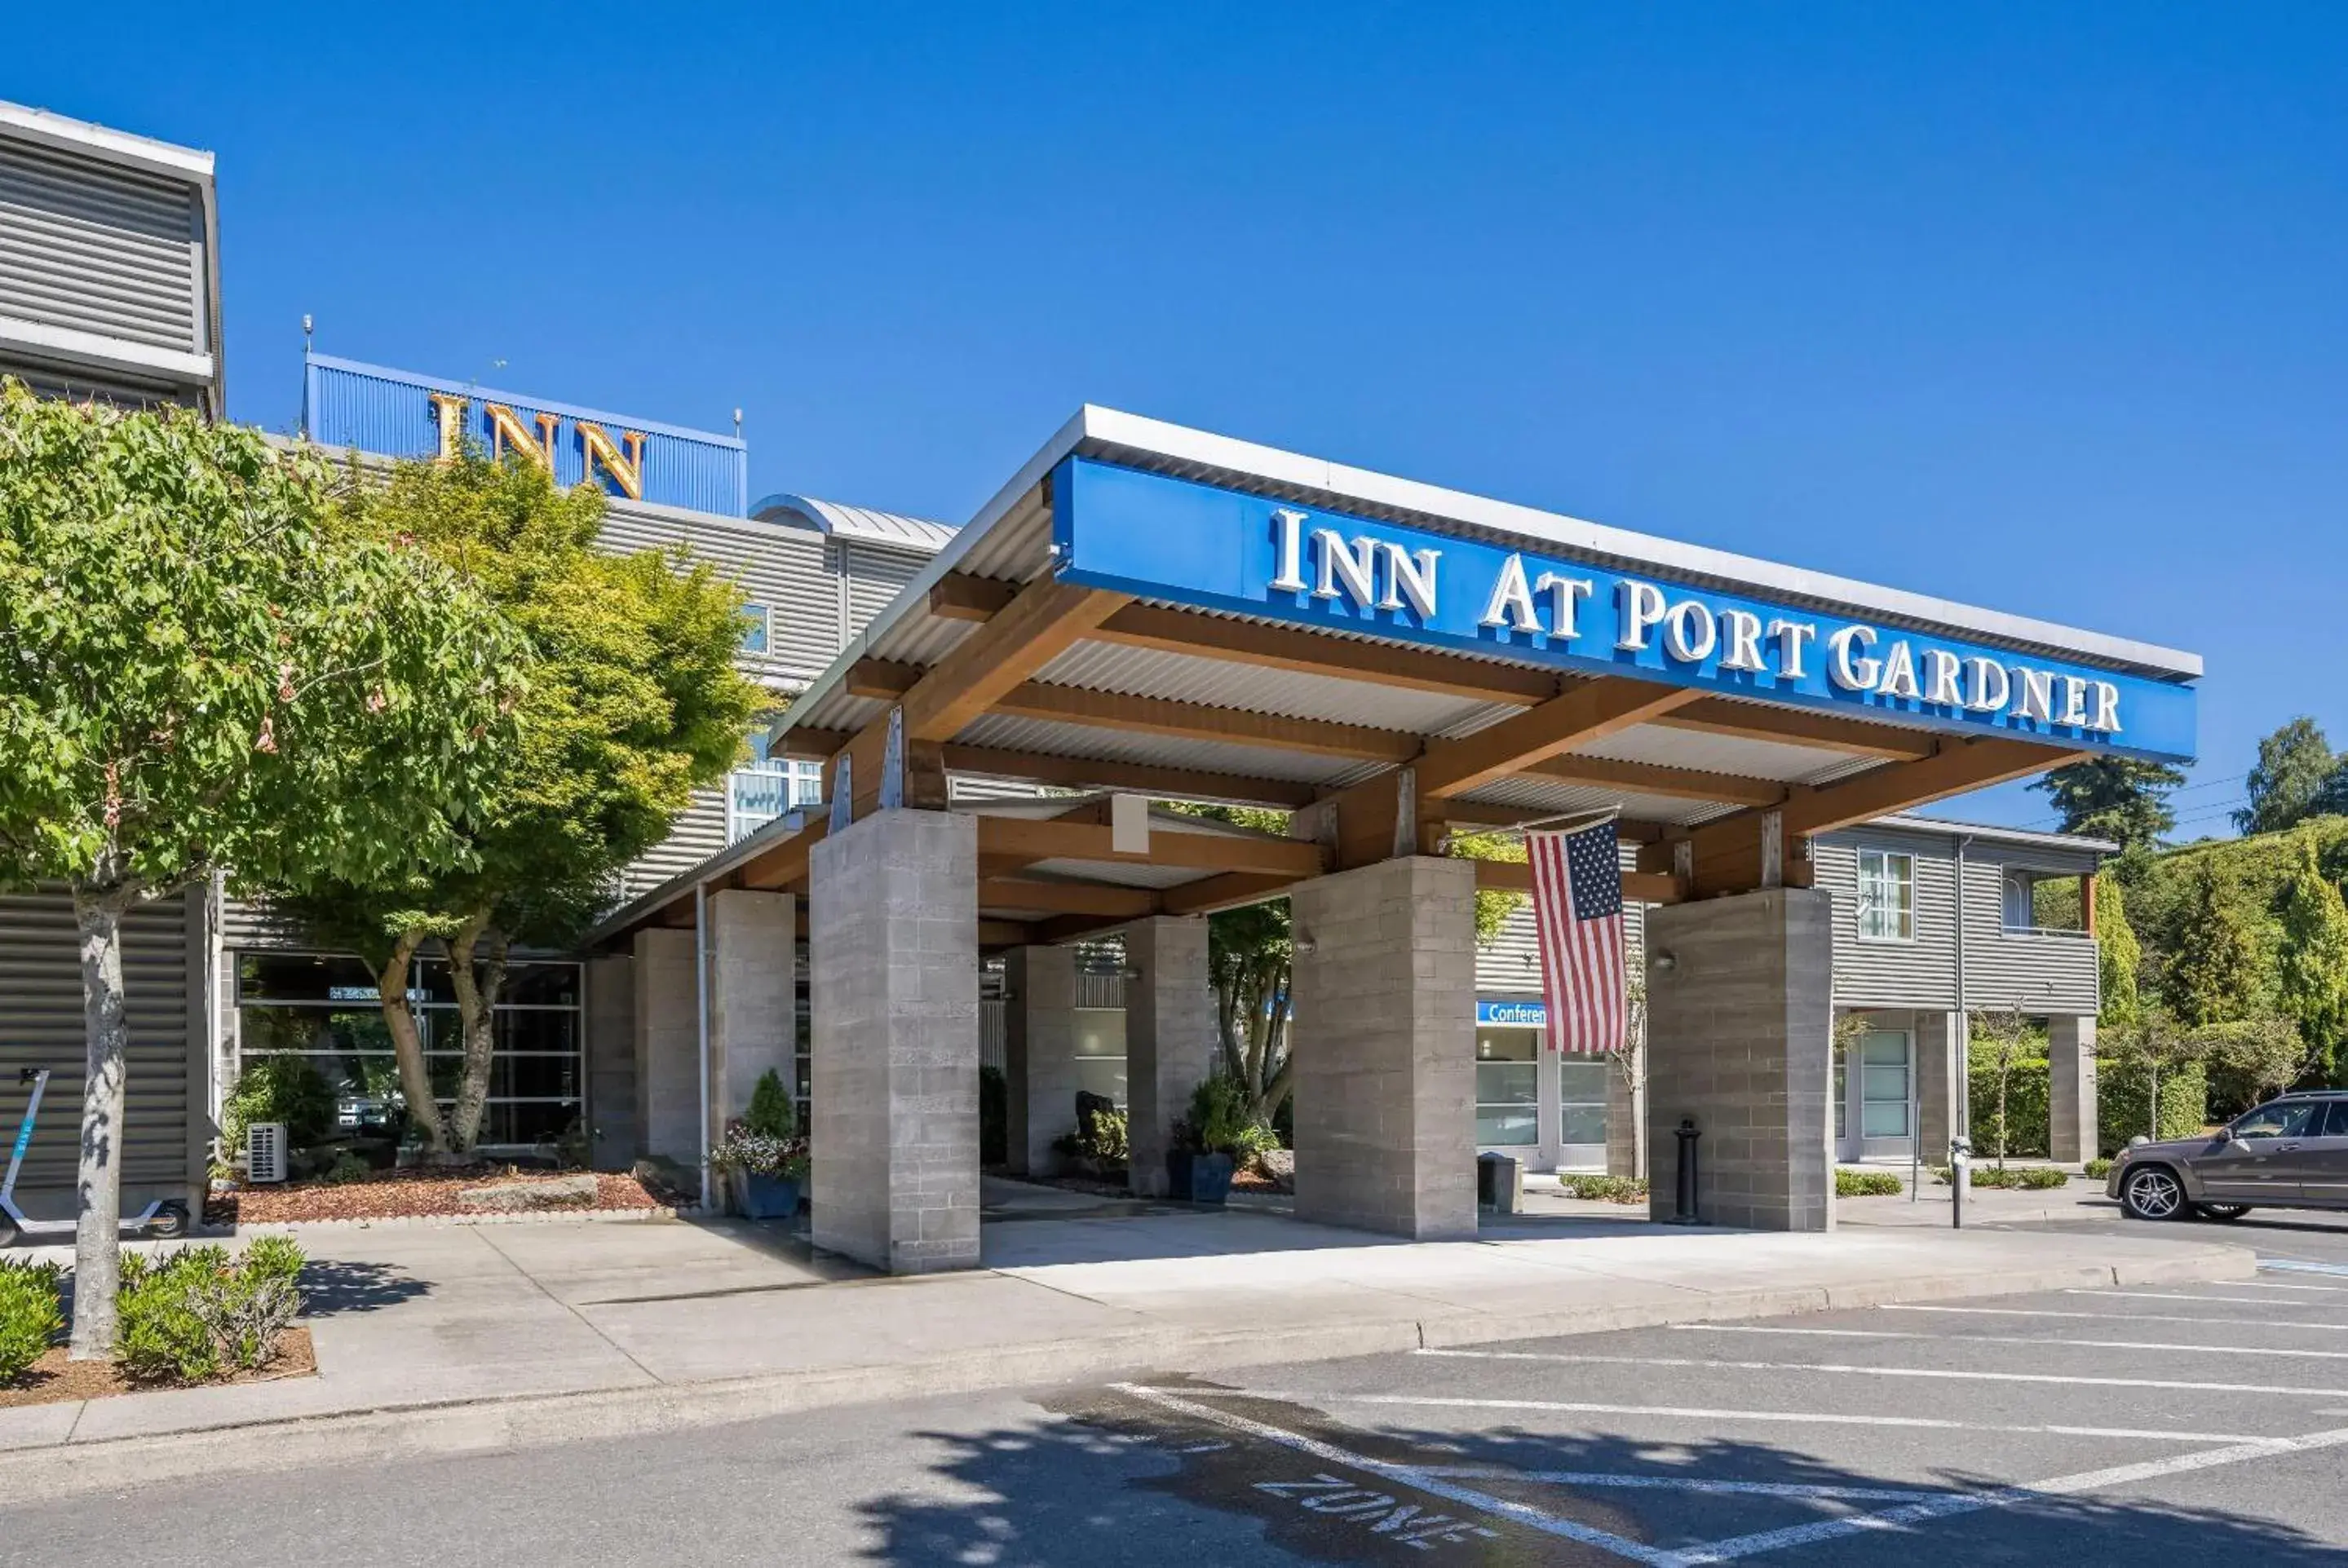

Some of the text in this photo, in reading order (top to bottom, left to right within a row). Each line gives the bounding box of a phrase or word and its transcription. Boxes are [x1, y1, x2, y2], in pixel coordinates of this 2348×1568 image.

[429, 392, 648, 501] INN
[1267, 507, 2123, 732] INN AT PORT GARDNER
[1489, 1004, 1546, 1022] Conferen
